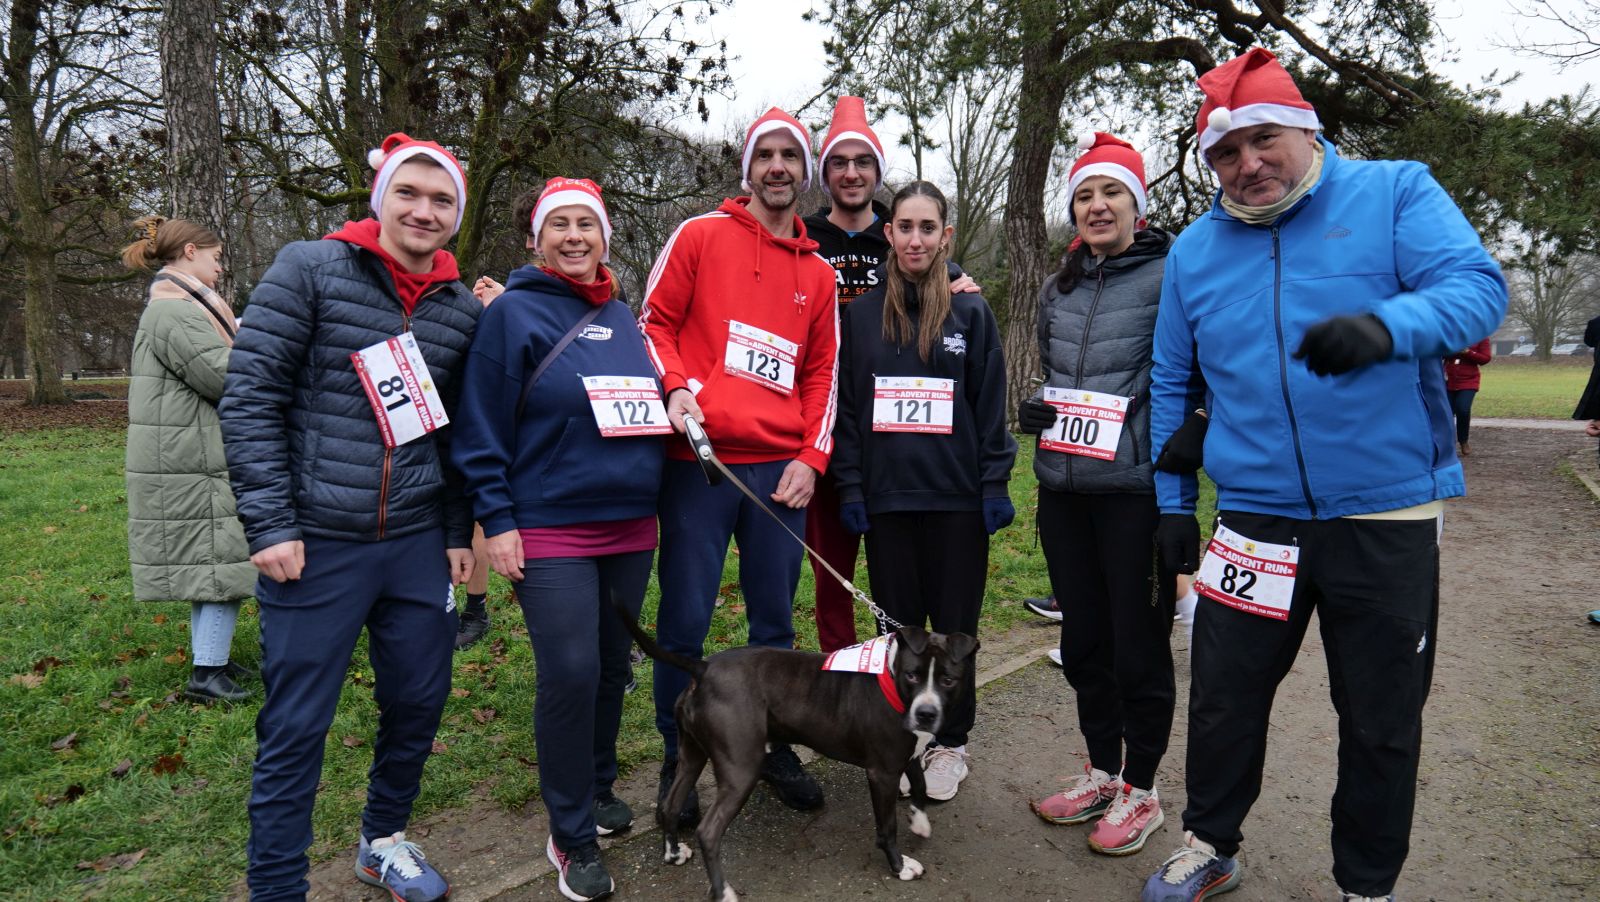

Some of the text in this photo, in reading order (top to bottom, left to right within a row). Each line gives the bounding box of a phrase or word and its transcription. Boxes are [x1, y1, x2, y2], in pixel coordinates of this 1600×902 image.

[746, 349, 780, 381] 123
[378, 375, 411, 412] 81
[613, 400, 654, 425] 122
[894, 400, 931, 423] 121
[1061, 416, 1099, 445] 100
[1221, 563, 1257, 600] 82
